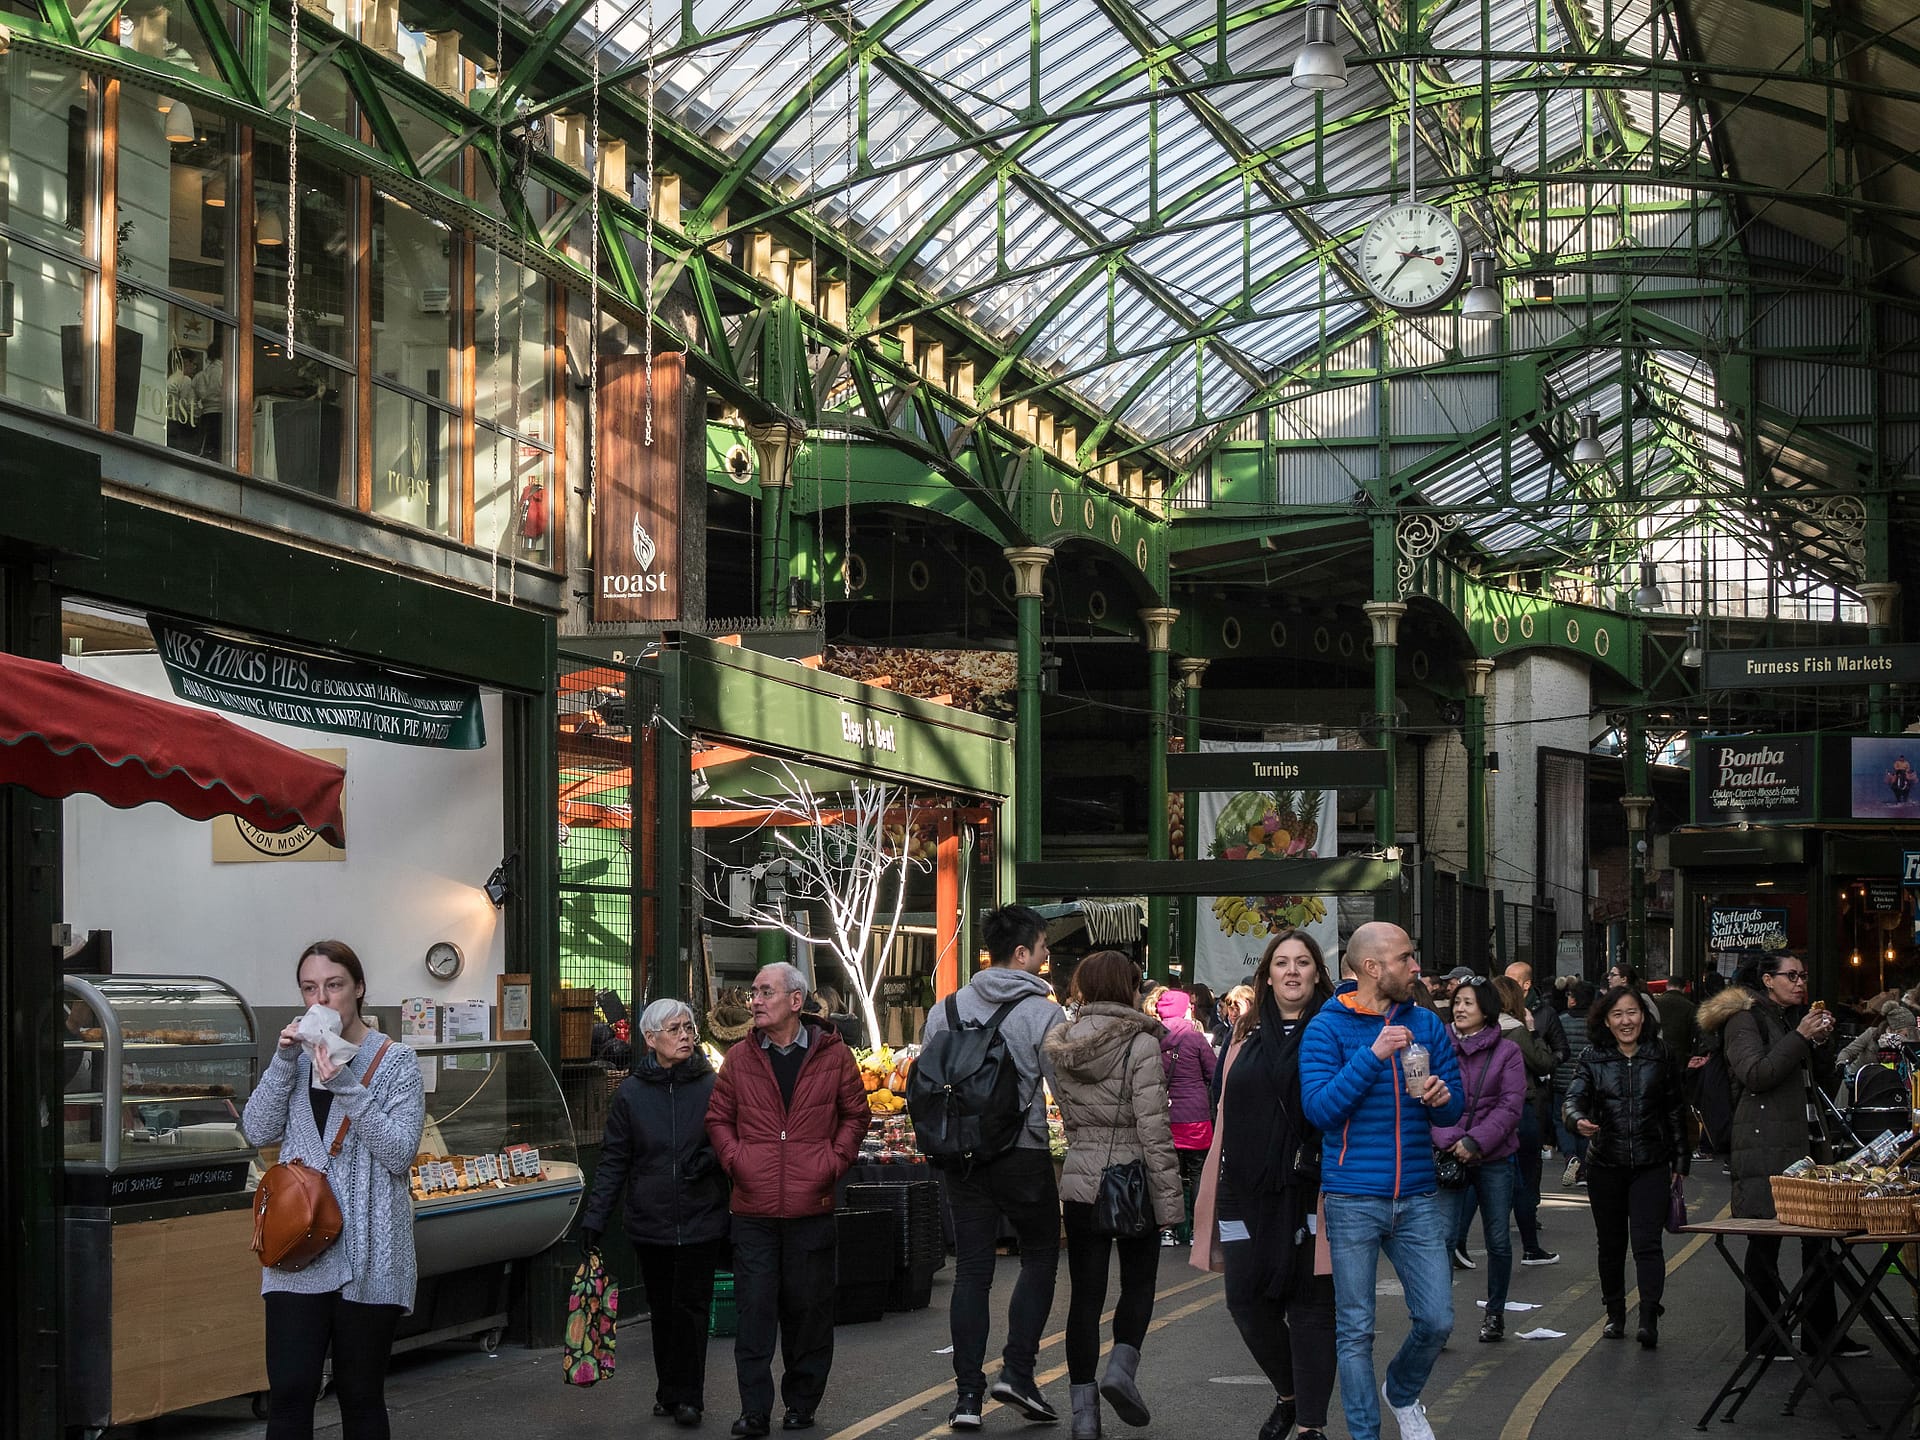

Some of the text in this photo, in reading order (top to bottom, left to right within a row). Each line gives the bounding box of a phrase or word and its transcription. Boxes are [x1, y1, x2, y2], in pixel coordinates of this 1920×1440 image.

[388, 470, 431, 505] roast
[603, 570, 668, 593] roast
[164, 628, 205, 669] MRS
[204, 644, 267, 684] KINGS
[271, 655, 308, 691] PIES
[311, 680, 322, 693] OF
[323, 680, 377, 699] BOROUGH
[411, 696, 440, 711] LONDON
[1747, 655, 1892, 675] Furness Fish Markets
[182, 676, 219, 703] AWARD
[216, 689, 267, 717] WINNING
[268, 700, 316, 724] MELTON
[315, 707, 373, 729] MOWBRAY
[373, 712, 400, 735] PORK
[403, 718, 420, 737] PIE
[840, 711, 896, 752] Elsey & Bent
[1718, 746, 1785, 767] Bomba
[1252, 761, 1300, 779] Turnips
[1719, 767, 1786, 787] Paella...
[1712, 909, 1762, 926] Shetlands
[1712, 920, 1779, 937] Salt & Pepper
[1710, 932, 1766, 951] Chilli Squid
[112, 1180, 128, 1195] HOT
[188, 1172, 204, 1186] HOT
